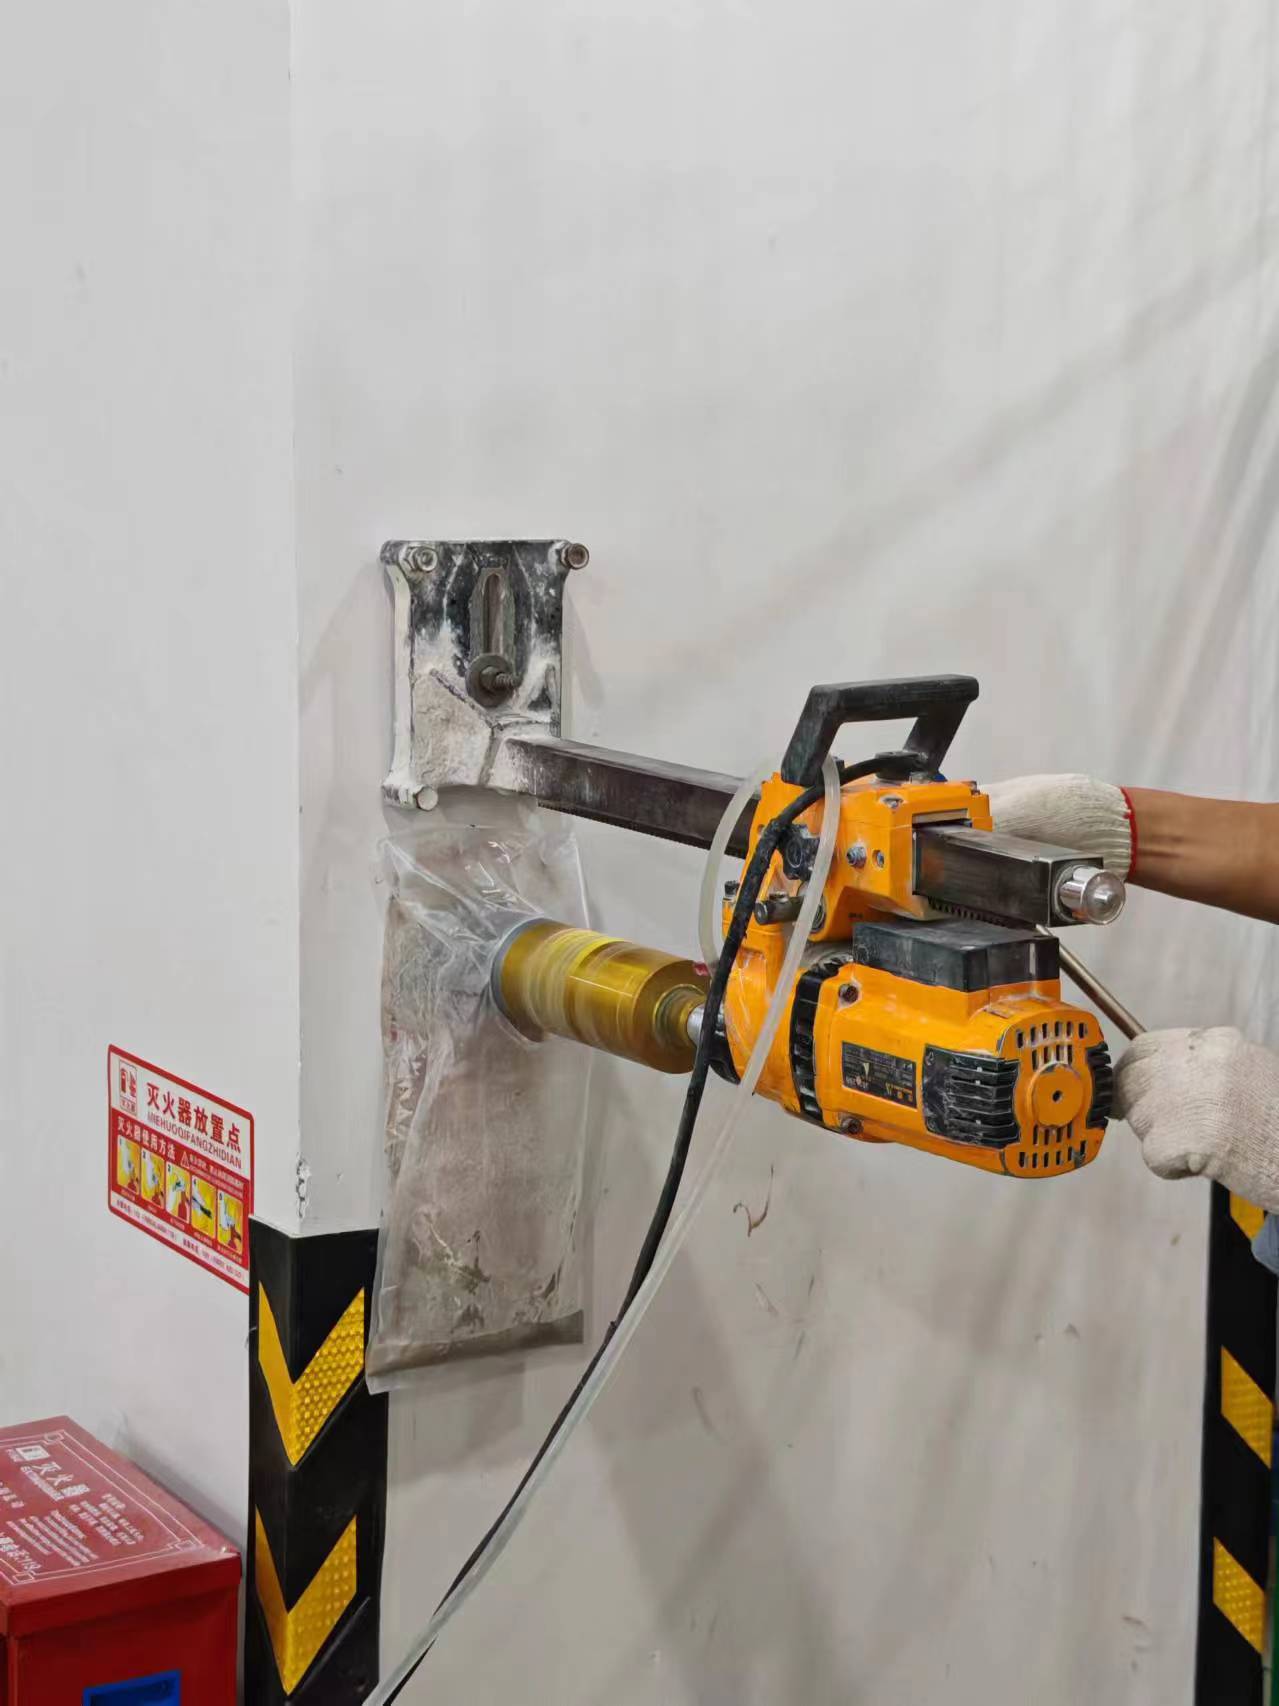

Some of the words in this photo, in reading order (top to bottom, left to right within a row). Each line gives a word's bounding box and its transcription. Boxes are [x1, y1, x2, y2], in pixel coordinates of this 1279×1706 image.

[118, 1116, 176, 1161] 灭火器使用方法
[147, 1082, 241, 1153] 灭火器放置点
